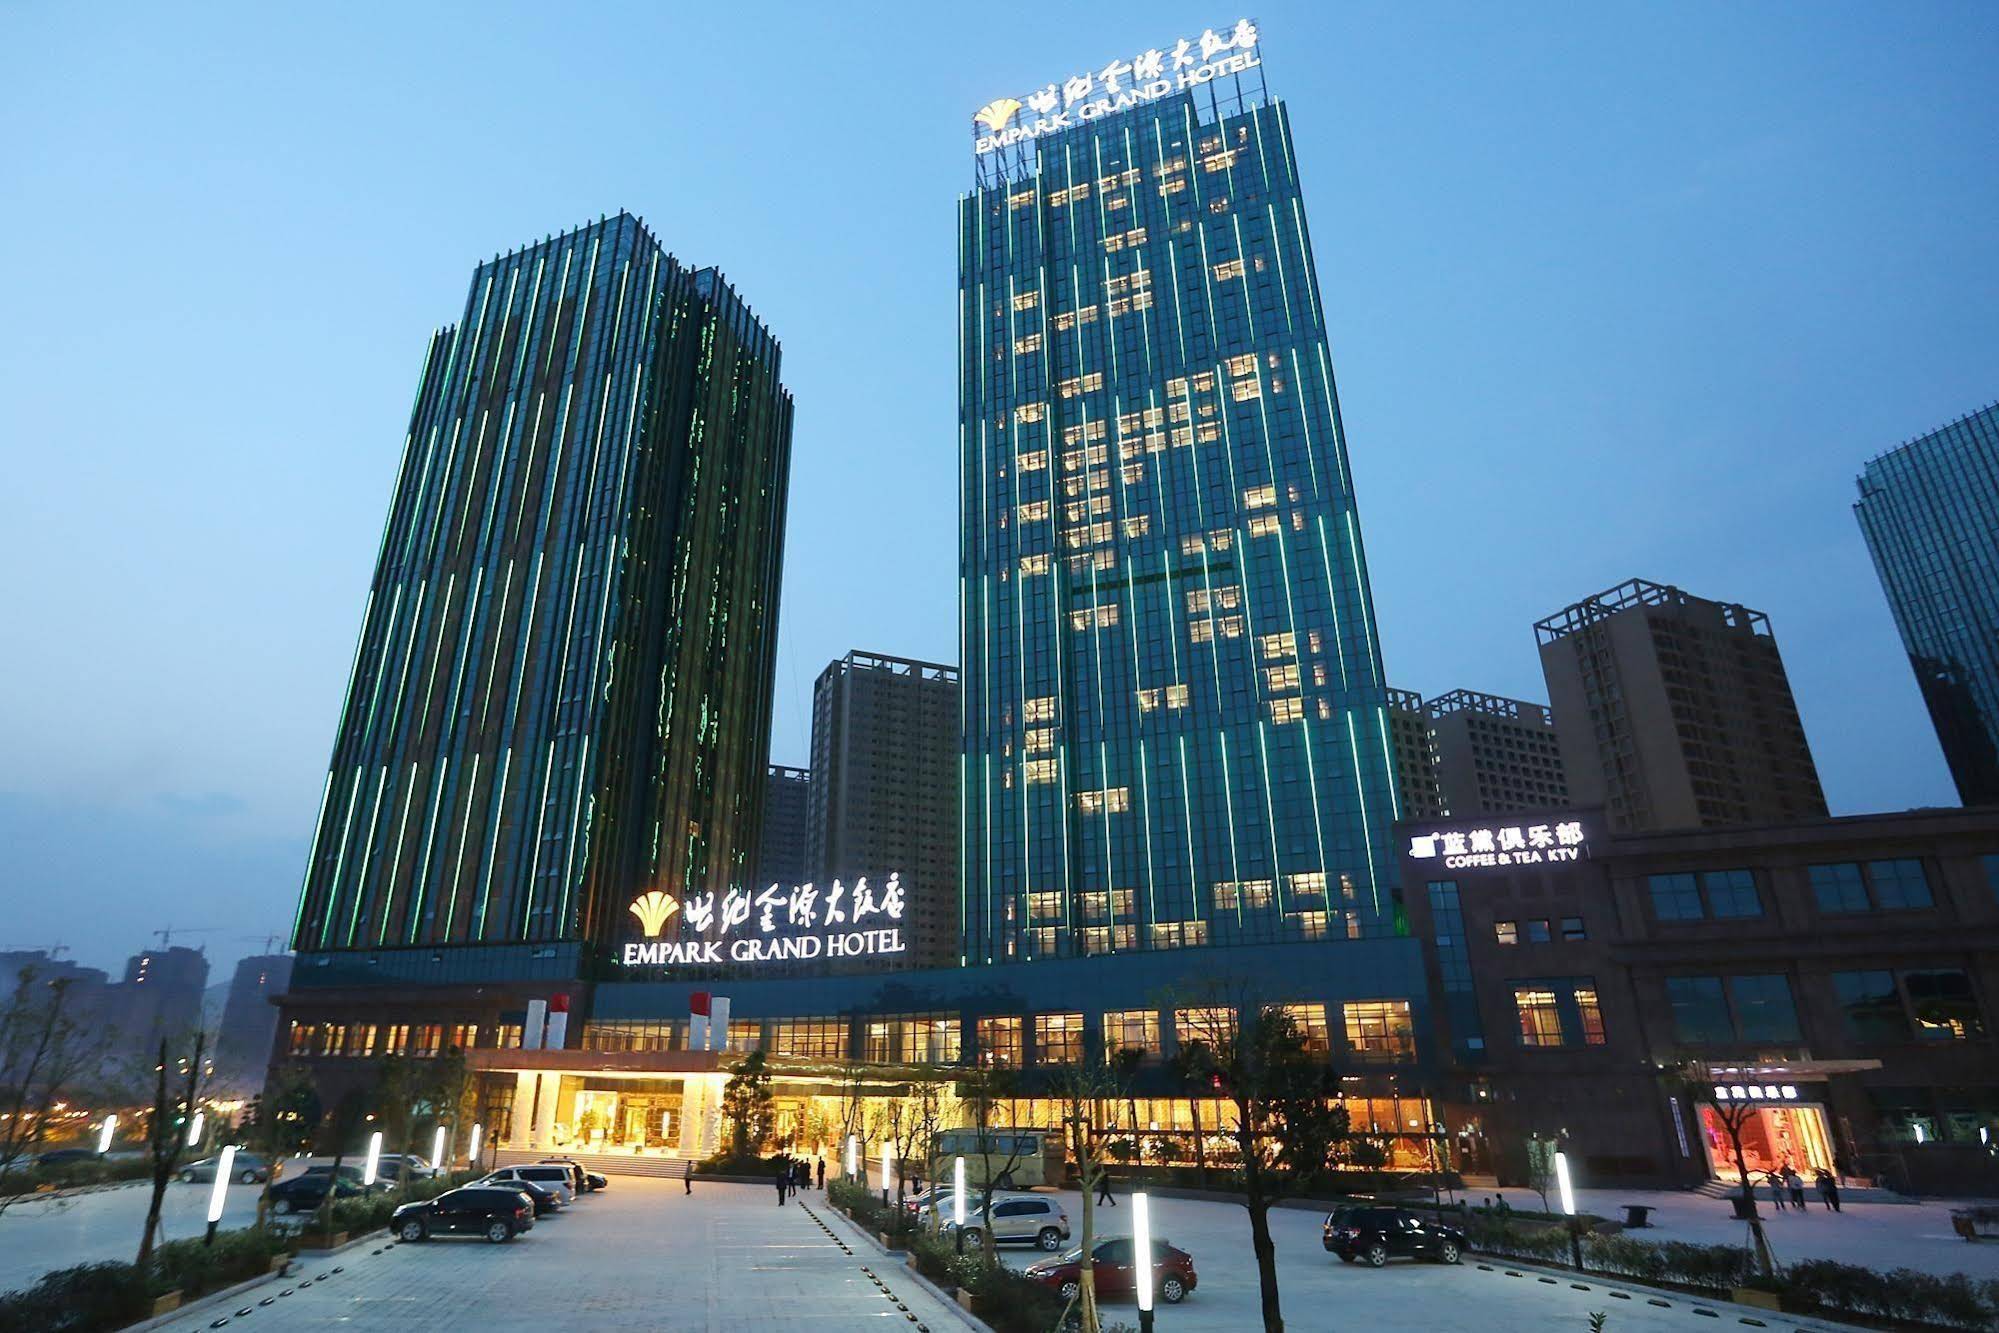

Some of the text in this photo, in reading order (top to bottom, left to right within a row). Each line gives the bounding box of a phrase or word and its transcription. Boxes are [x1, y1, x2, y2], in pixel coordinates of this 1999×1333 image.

[976, 51, 1260, 154] EMPARK GRAND HOTEL
[1445, 847, 1578, 868] COFFEE & TEA KTV
[623, 928, 906, 965] EMPARK GRAND HOTEL
